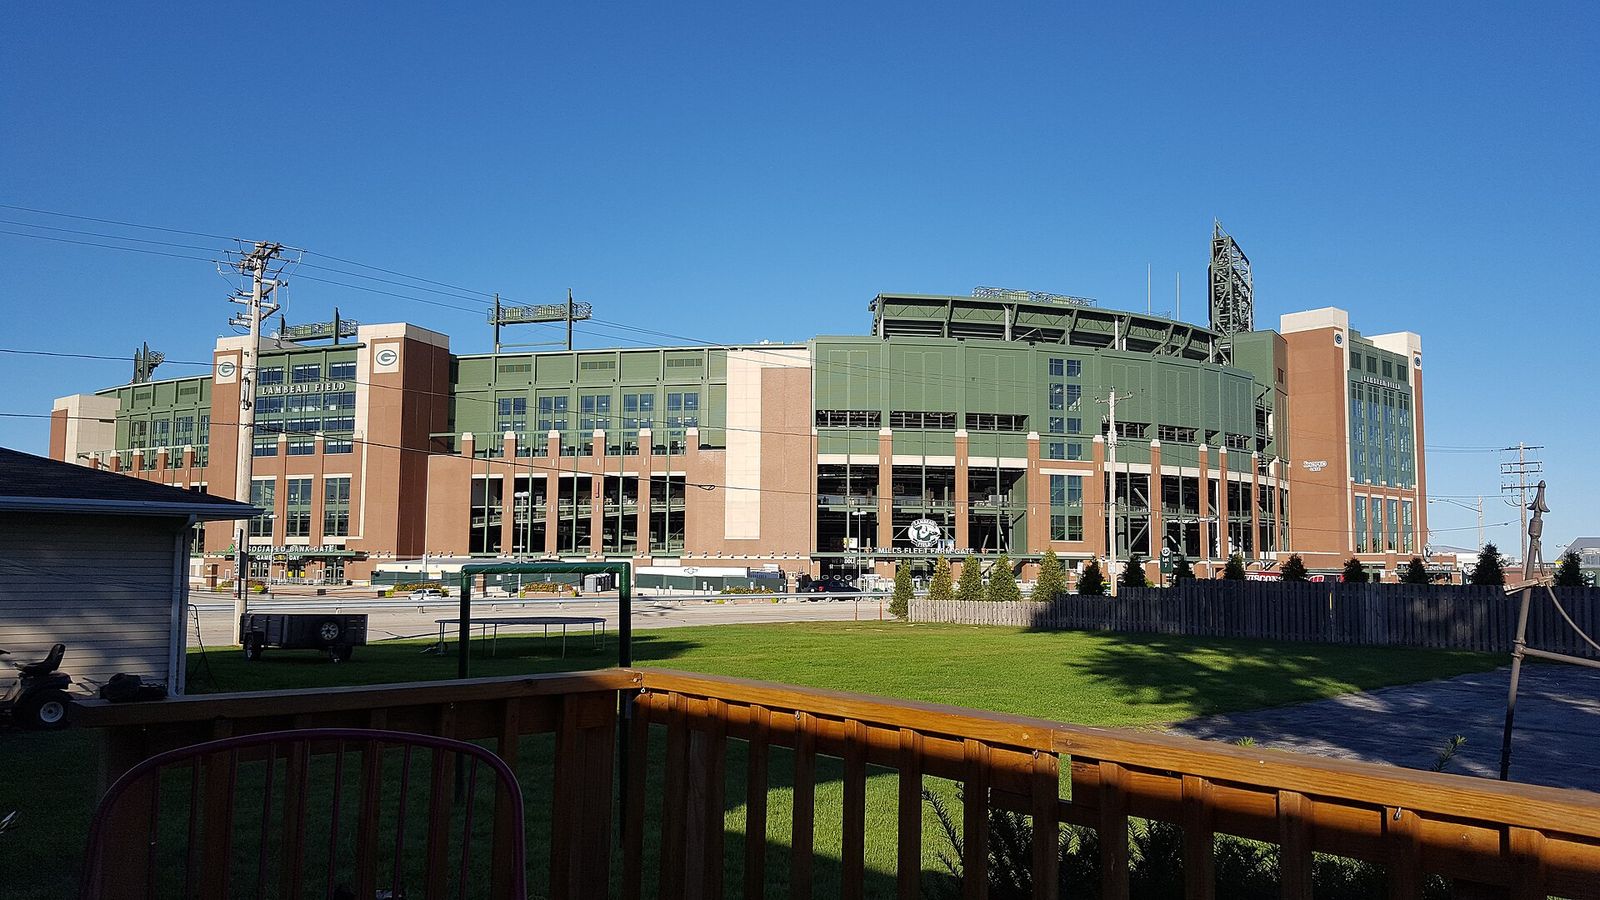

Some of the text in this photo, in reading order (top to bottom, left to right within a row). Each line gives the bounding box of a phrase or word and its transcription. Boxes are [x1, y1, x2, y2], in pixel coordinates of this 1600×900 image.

[262, 382, 346, 396] LAMBEAU FIELD
[289, 545, 310, 553] BANK
[313, 545, 334, 553] GATE
